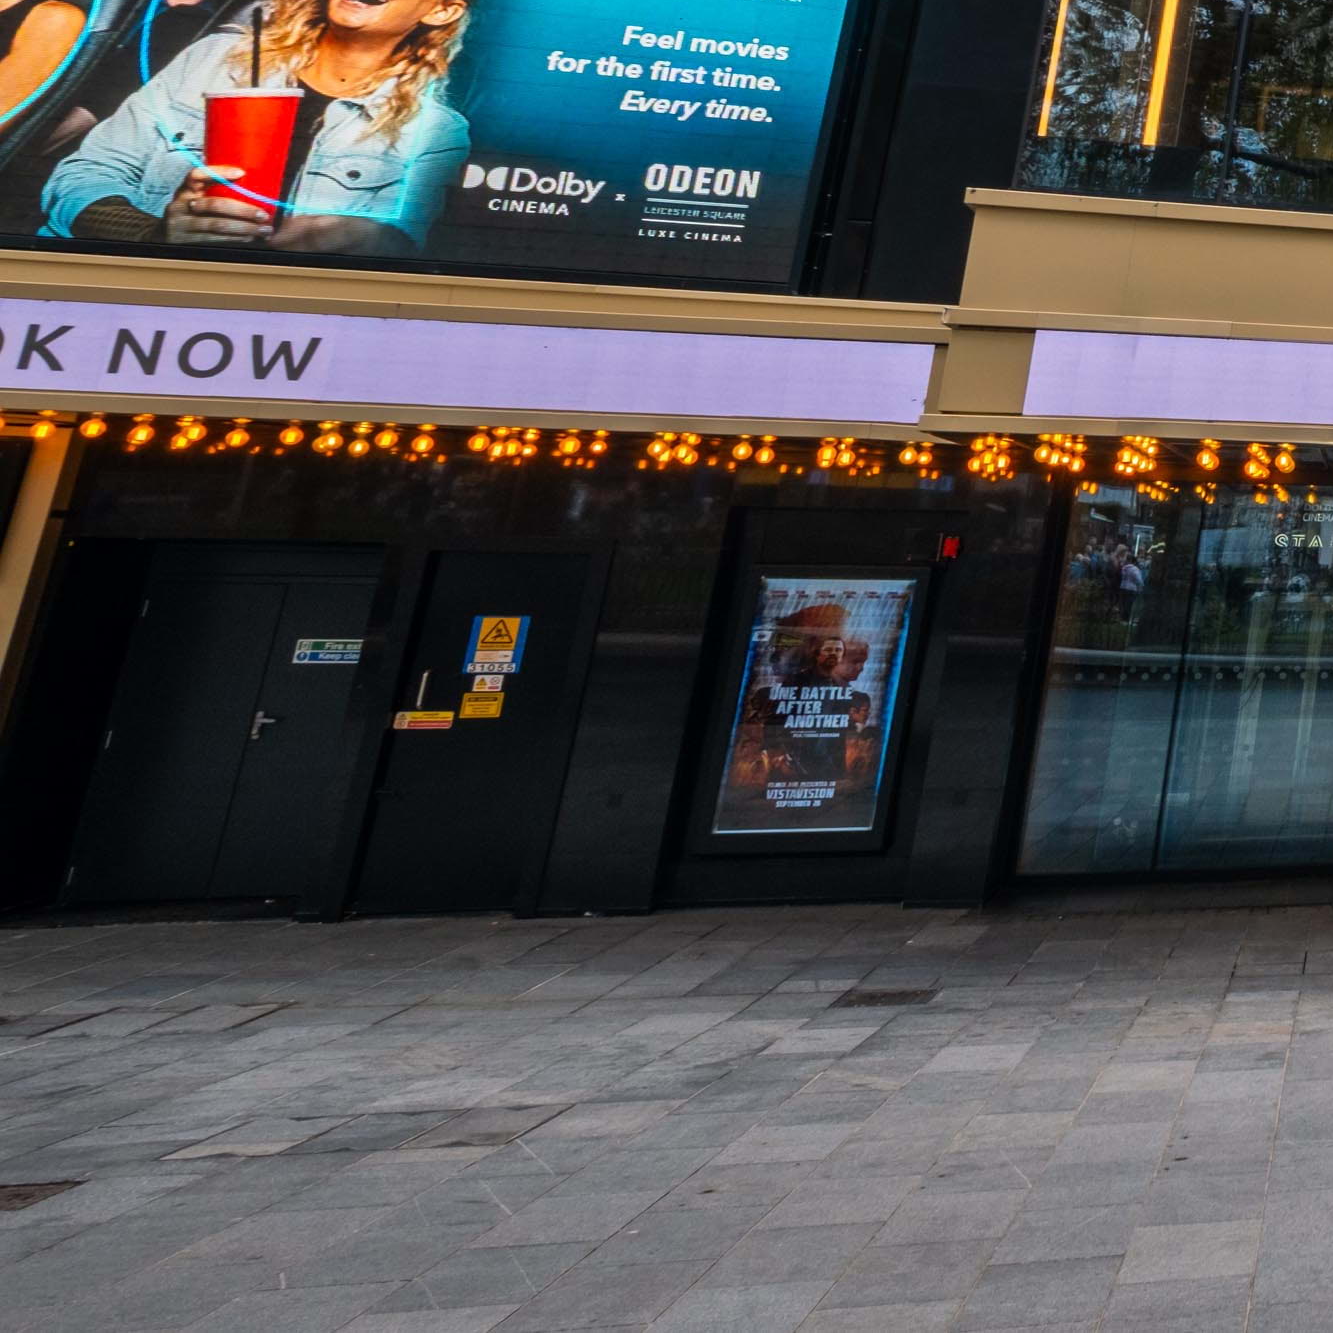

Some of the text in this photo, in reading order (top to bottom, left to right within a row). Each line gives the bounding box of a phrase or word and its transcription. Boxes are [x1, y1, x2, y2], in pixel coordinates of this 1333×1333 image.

[623, 25, 789, 61] Feel movies
[547, 51, 781, 92] for the first time.
[620, 90, 773, 123] Every time.
[509, 168, 606, 203] Dolby
[644, 163, 761, 198] ODEON
[488, 198, 569, 216] CINEMA
[644, 206, 746, 221] LEICESTER SQUARE
[638, 228, 743, 243] LUXE CINEMA
[0, 323, 323, 381] K NOW
[469, 663, 514, 672] 31055
[801, 686, 853, 700] BATTLE
[776, 700, 822, 714] AFTER
[784, 714, 849, 728] ANOTHER
[767, 788, 835, 800] VISTAVISION
